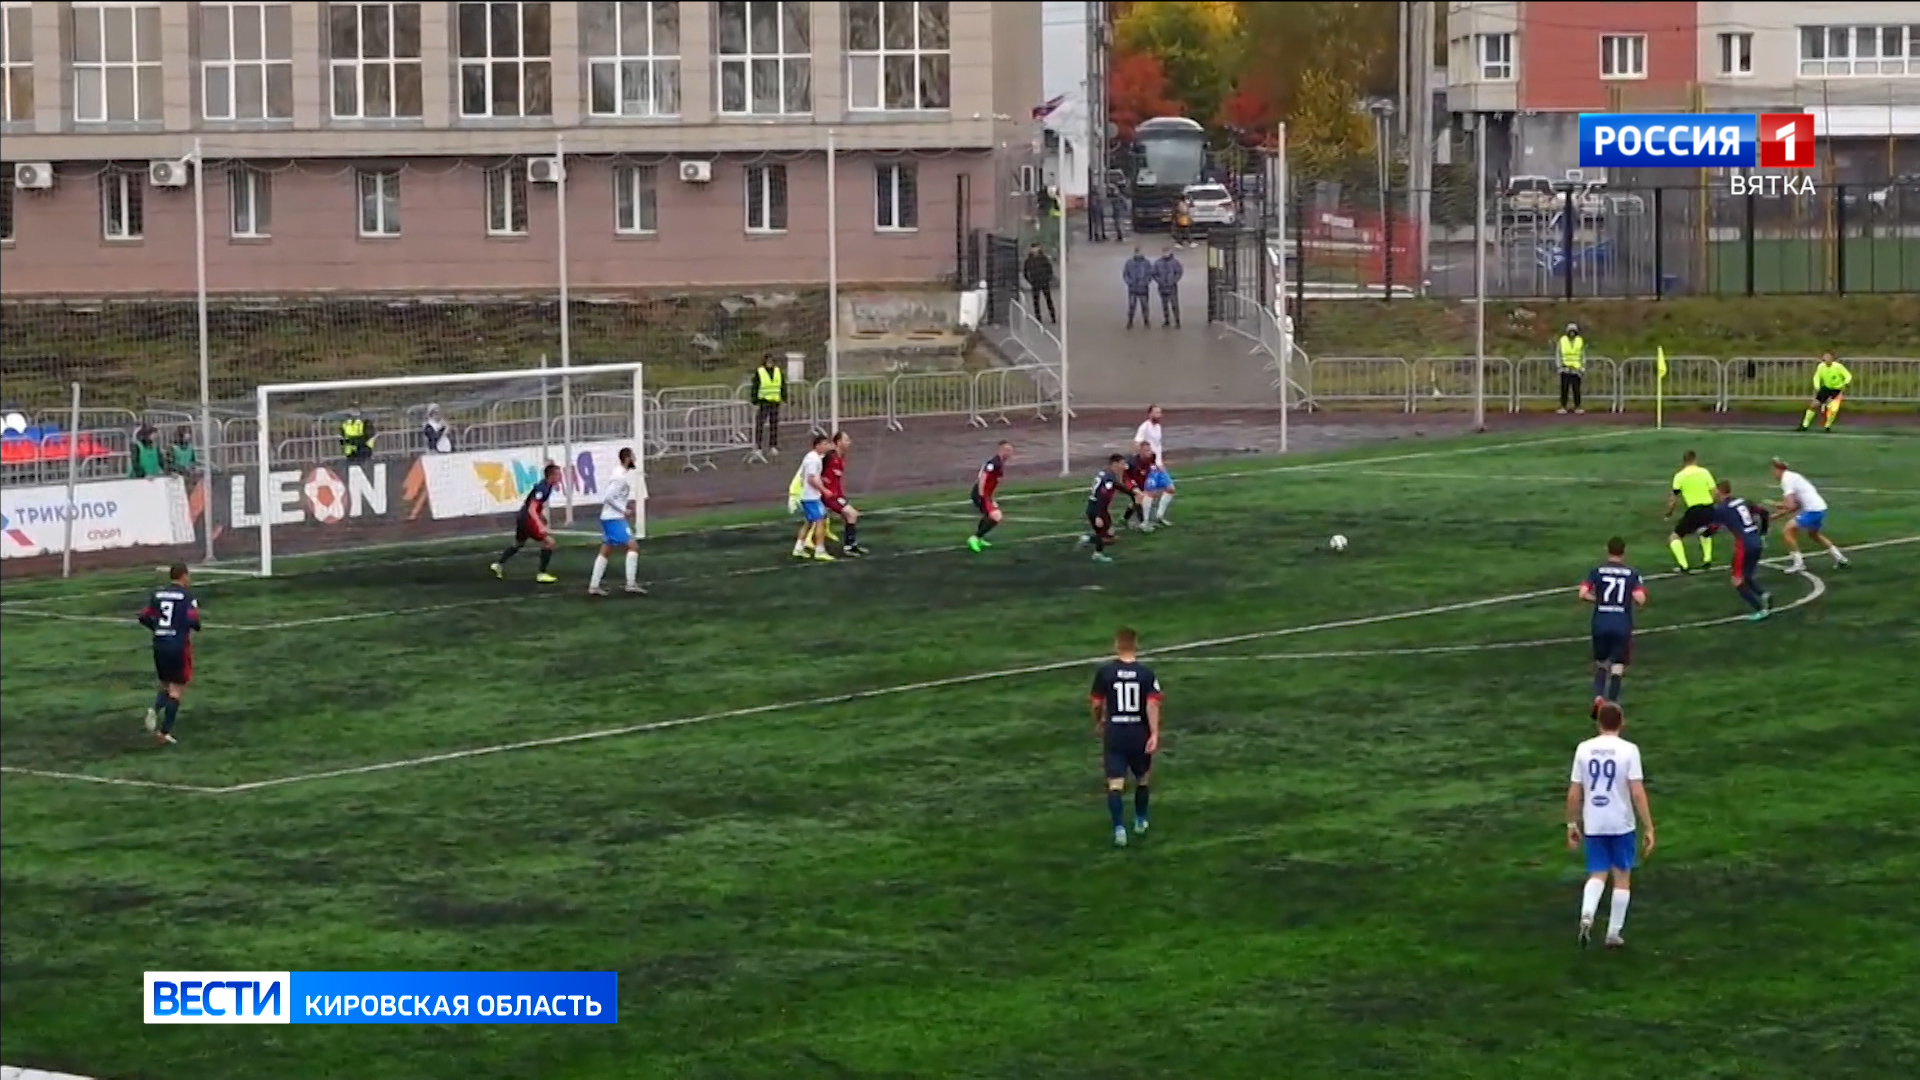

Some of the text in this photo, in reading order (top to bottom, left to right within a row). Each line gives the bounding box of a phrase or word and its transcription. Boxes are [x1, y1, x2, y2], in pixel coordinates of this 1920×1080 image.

[231, 463, 387, 528] LEON
[15, 500, 118, 525] ТРИКОЛОР
[1602, 576, 1626, 604] 71
[159, 600, 174, 627] 3
[1112, 681, 1140, 712] 10
[1589, 759, 1616, 791] 99
